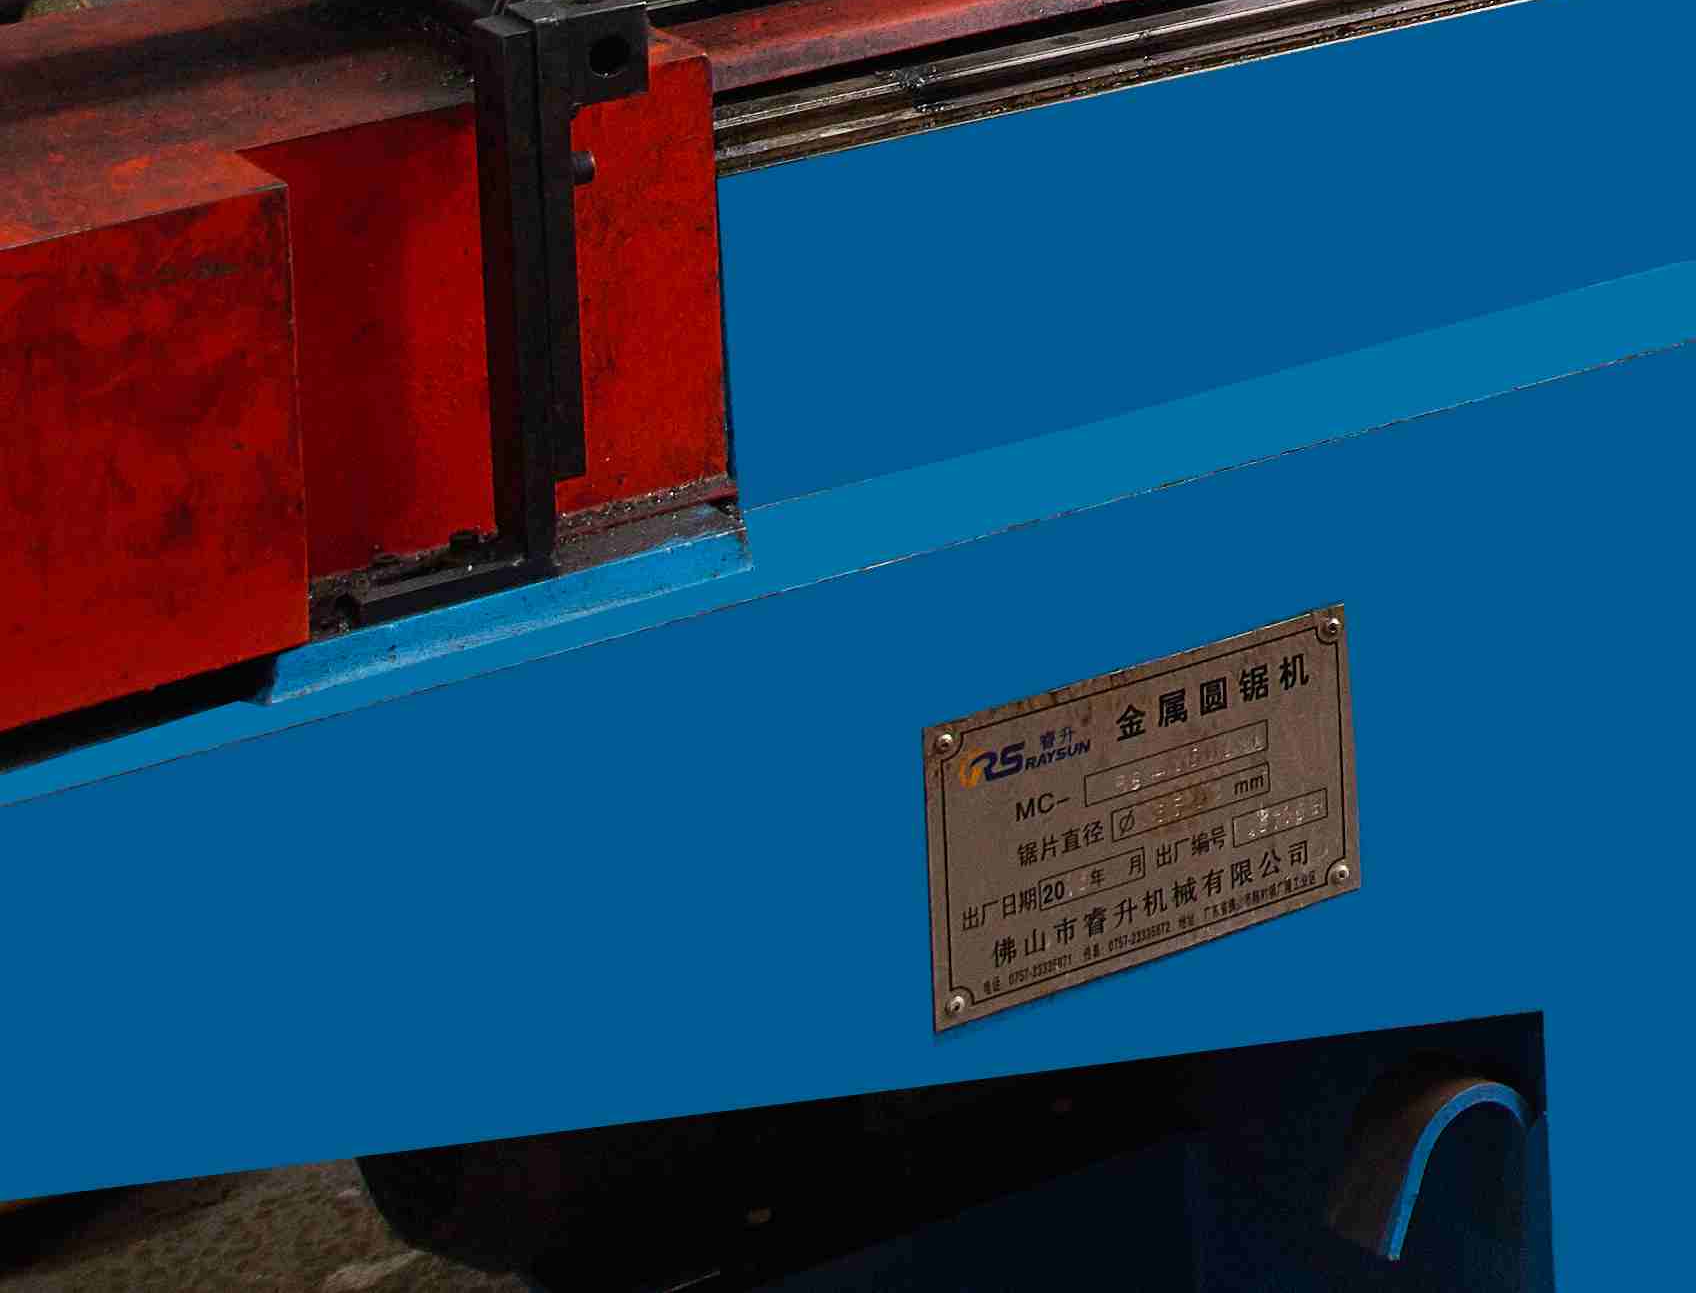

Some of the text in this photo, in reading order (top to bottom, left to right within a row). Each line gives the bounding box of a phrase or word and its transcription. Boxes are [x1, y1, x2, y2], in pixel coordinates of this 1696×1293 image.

[1117, 652, 1309, 742] 金属圆锯机
[1025, 739, 1091, 771] RAYSUN
[1017, 821, 1104, 867] 锯片直径
[1234, 773, 1264, 796] mm
[962, 887, 1038, 931] 出厂日期
[1156, 825, 1227, 867] 出厂编号
[992, 840, 1309, 969] 佛山市睿升机械有限公司
